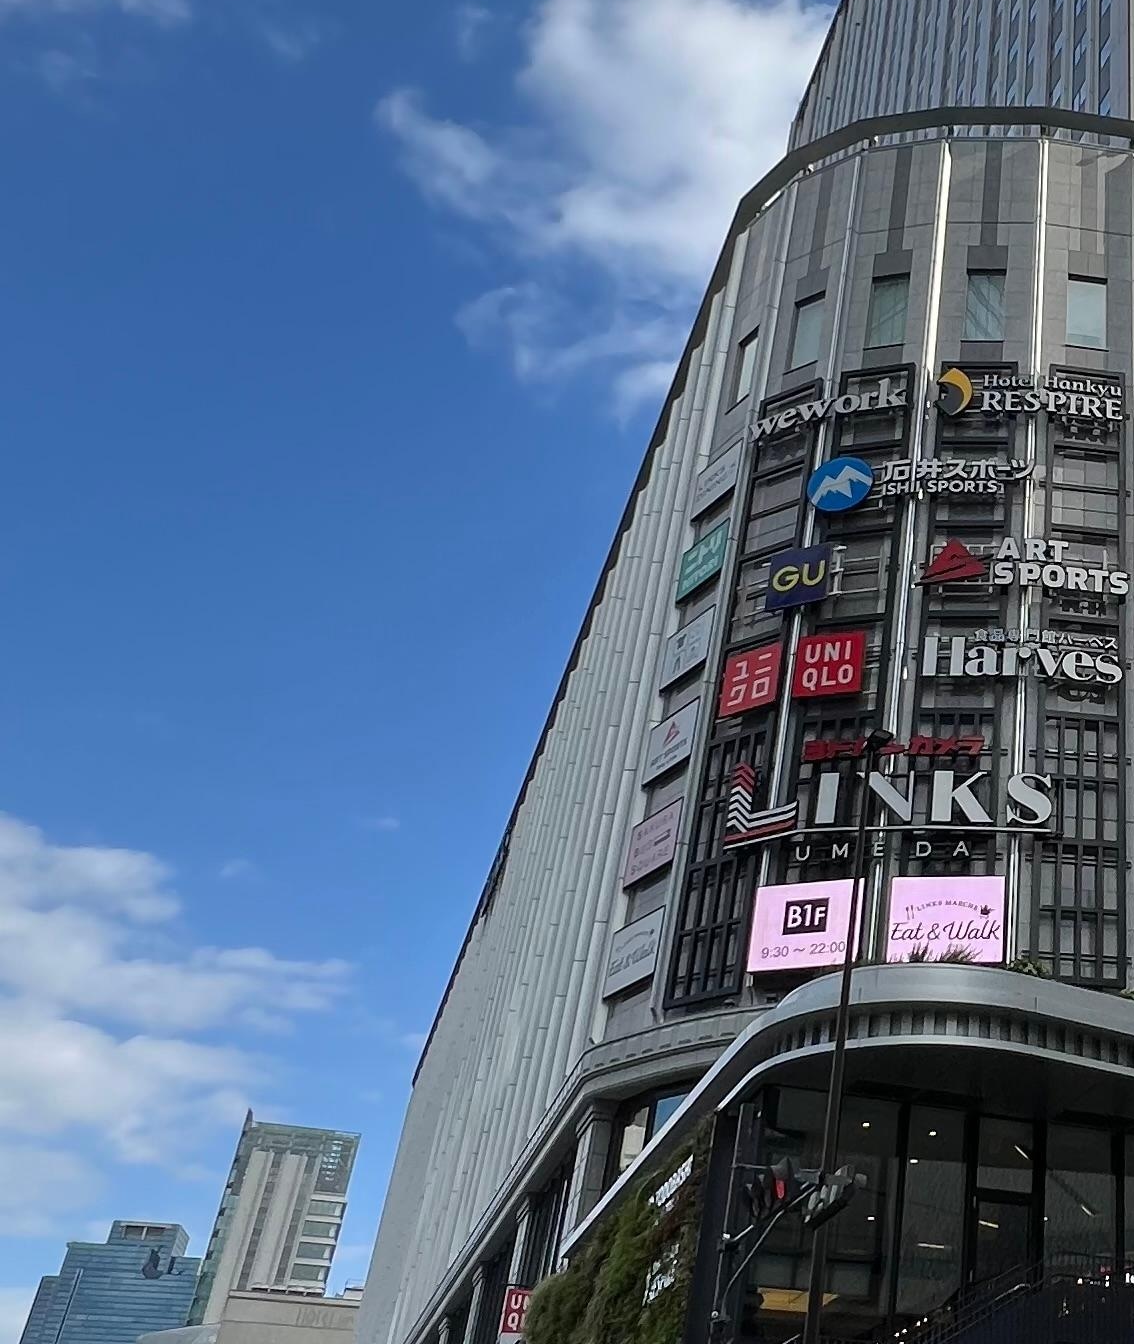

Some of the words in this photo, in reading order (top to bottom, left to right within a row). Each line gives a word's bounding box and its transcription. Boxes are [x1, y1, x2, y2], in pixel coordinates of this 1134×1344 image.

[983, 374, 1034, 387] Hotel
[1045, 375, 1122, 397] Hankyu
[749, 377, 907, 442] wework
[980, 390, 1123, 420] RESPIRE
[882, 458, 1034, 481] 石井スポーツ
[926, 479, 999, 493] SPORTS
[996, 537, 1069, 563] ART
[772, 559, 826, 592] GU
[994, 562, 1130, 595] SPORTS
[922, 636, 1124, 684] Harves
[795, 840, 970, 862] UMEDA
[786, 904, 827, 929] B1F
[890, 921, 926, 941] Eat
[926, 923, 940, 941] &
[942, 919, 1001, 941] Walk
[761, 945, 789, 959] 9:30
[810, 941, 846, 955] 22:00
